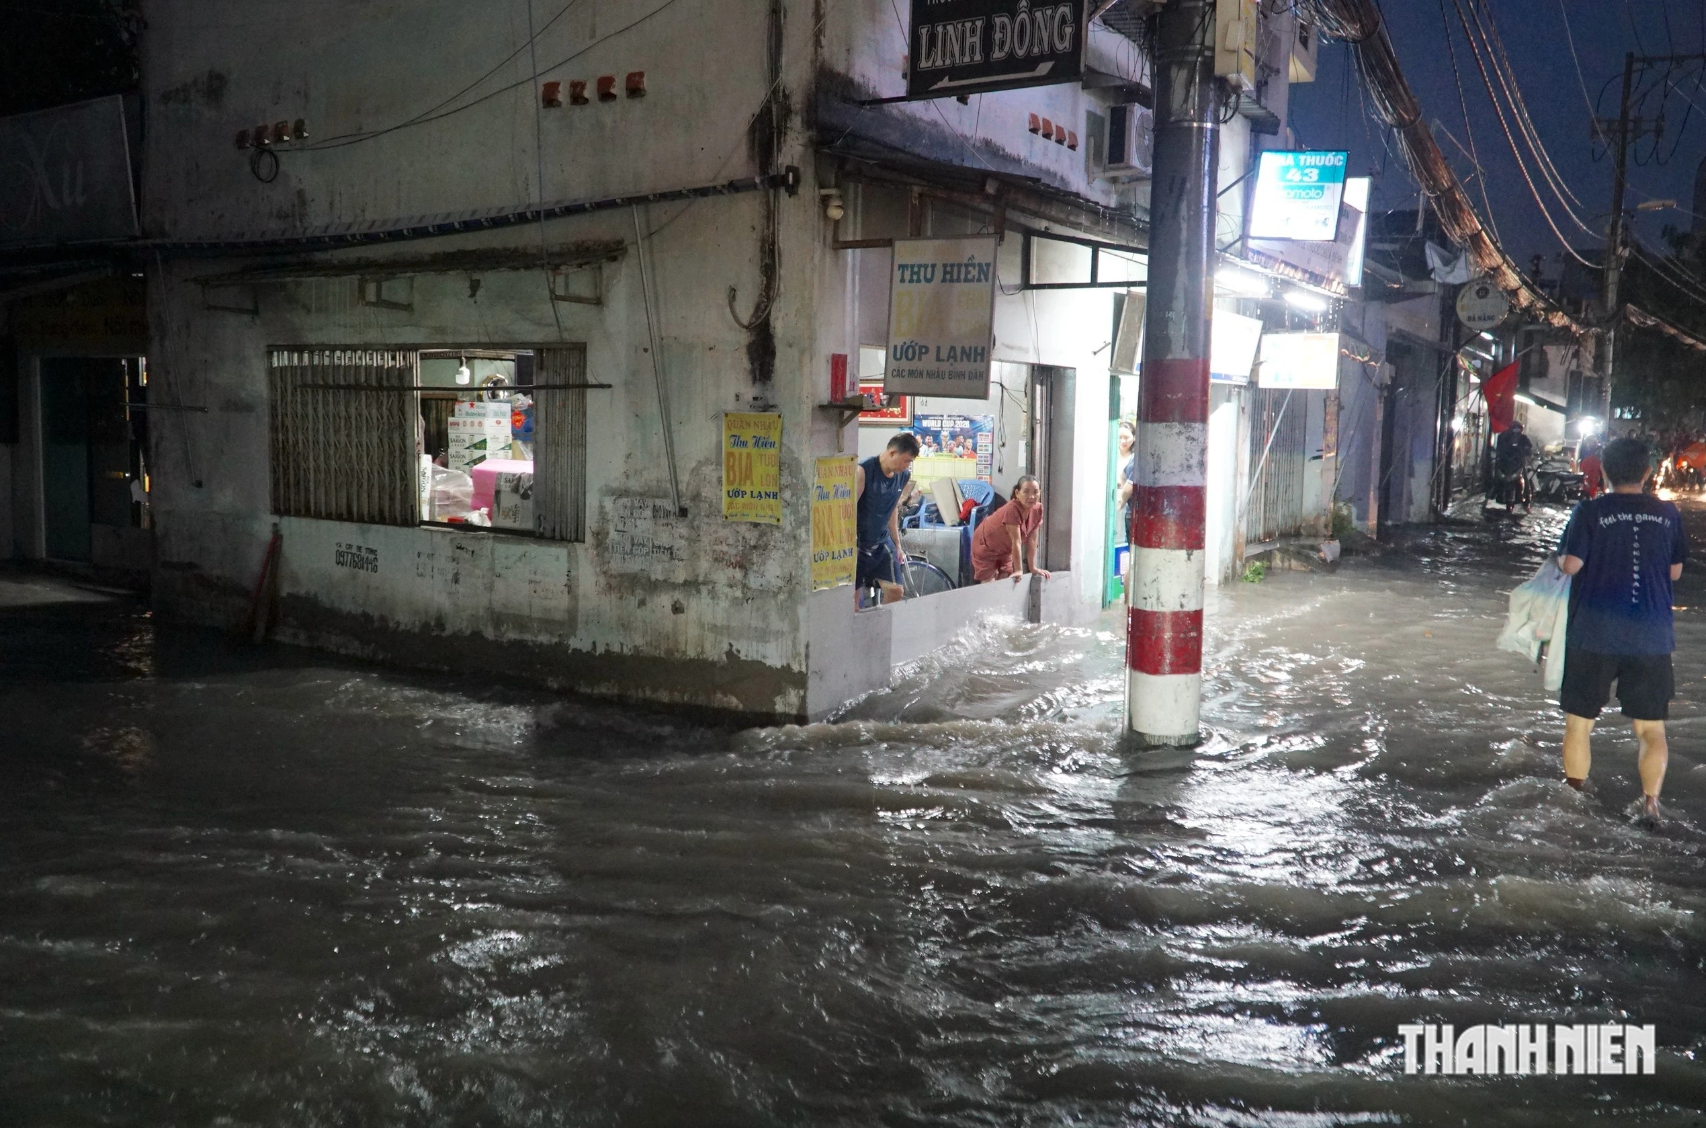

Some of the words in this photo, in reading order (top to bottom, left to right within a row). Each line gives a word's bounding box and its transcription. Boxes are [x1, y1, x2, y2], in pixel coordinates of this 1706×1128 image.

[918, 16, 986, 71] LINH
[990, 0, 1075, 61] ĐÔNG
[1299, 151, 1344, 167] THUỐC
[1285, 168, 1320, 183] 43
[897, 263, 937, 284] THU
[940, 254, 992, 284] HIỀN
[892, 340, 930, 362] ƯỚP
[934, 345, 986, 366] LẠNH
[891, 366, 906, 379] CÁC
[922, 420, 941, 428] WORLD
[942, 420, 954, 429] CUP
[726, 450, 755, 488] BIA
[727, 488, 748, 499] ƯỚP
[750, 490, 778, 501] LẠNH
[1600, 516, 1617, 529] feel
[1617, 512, 1632, 522] the
[1634, 513, 1663, 524] game
[831, 546, 853, 561] LẠNH
